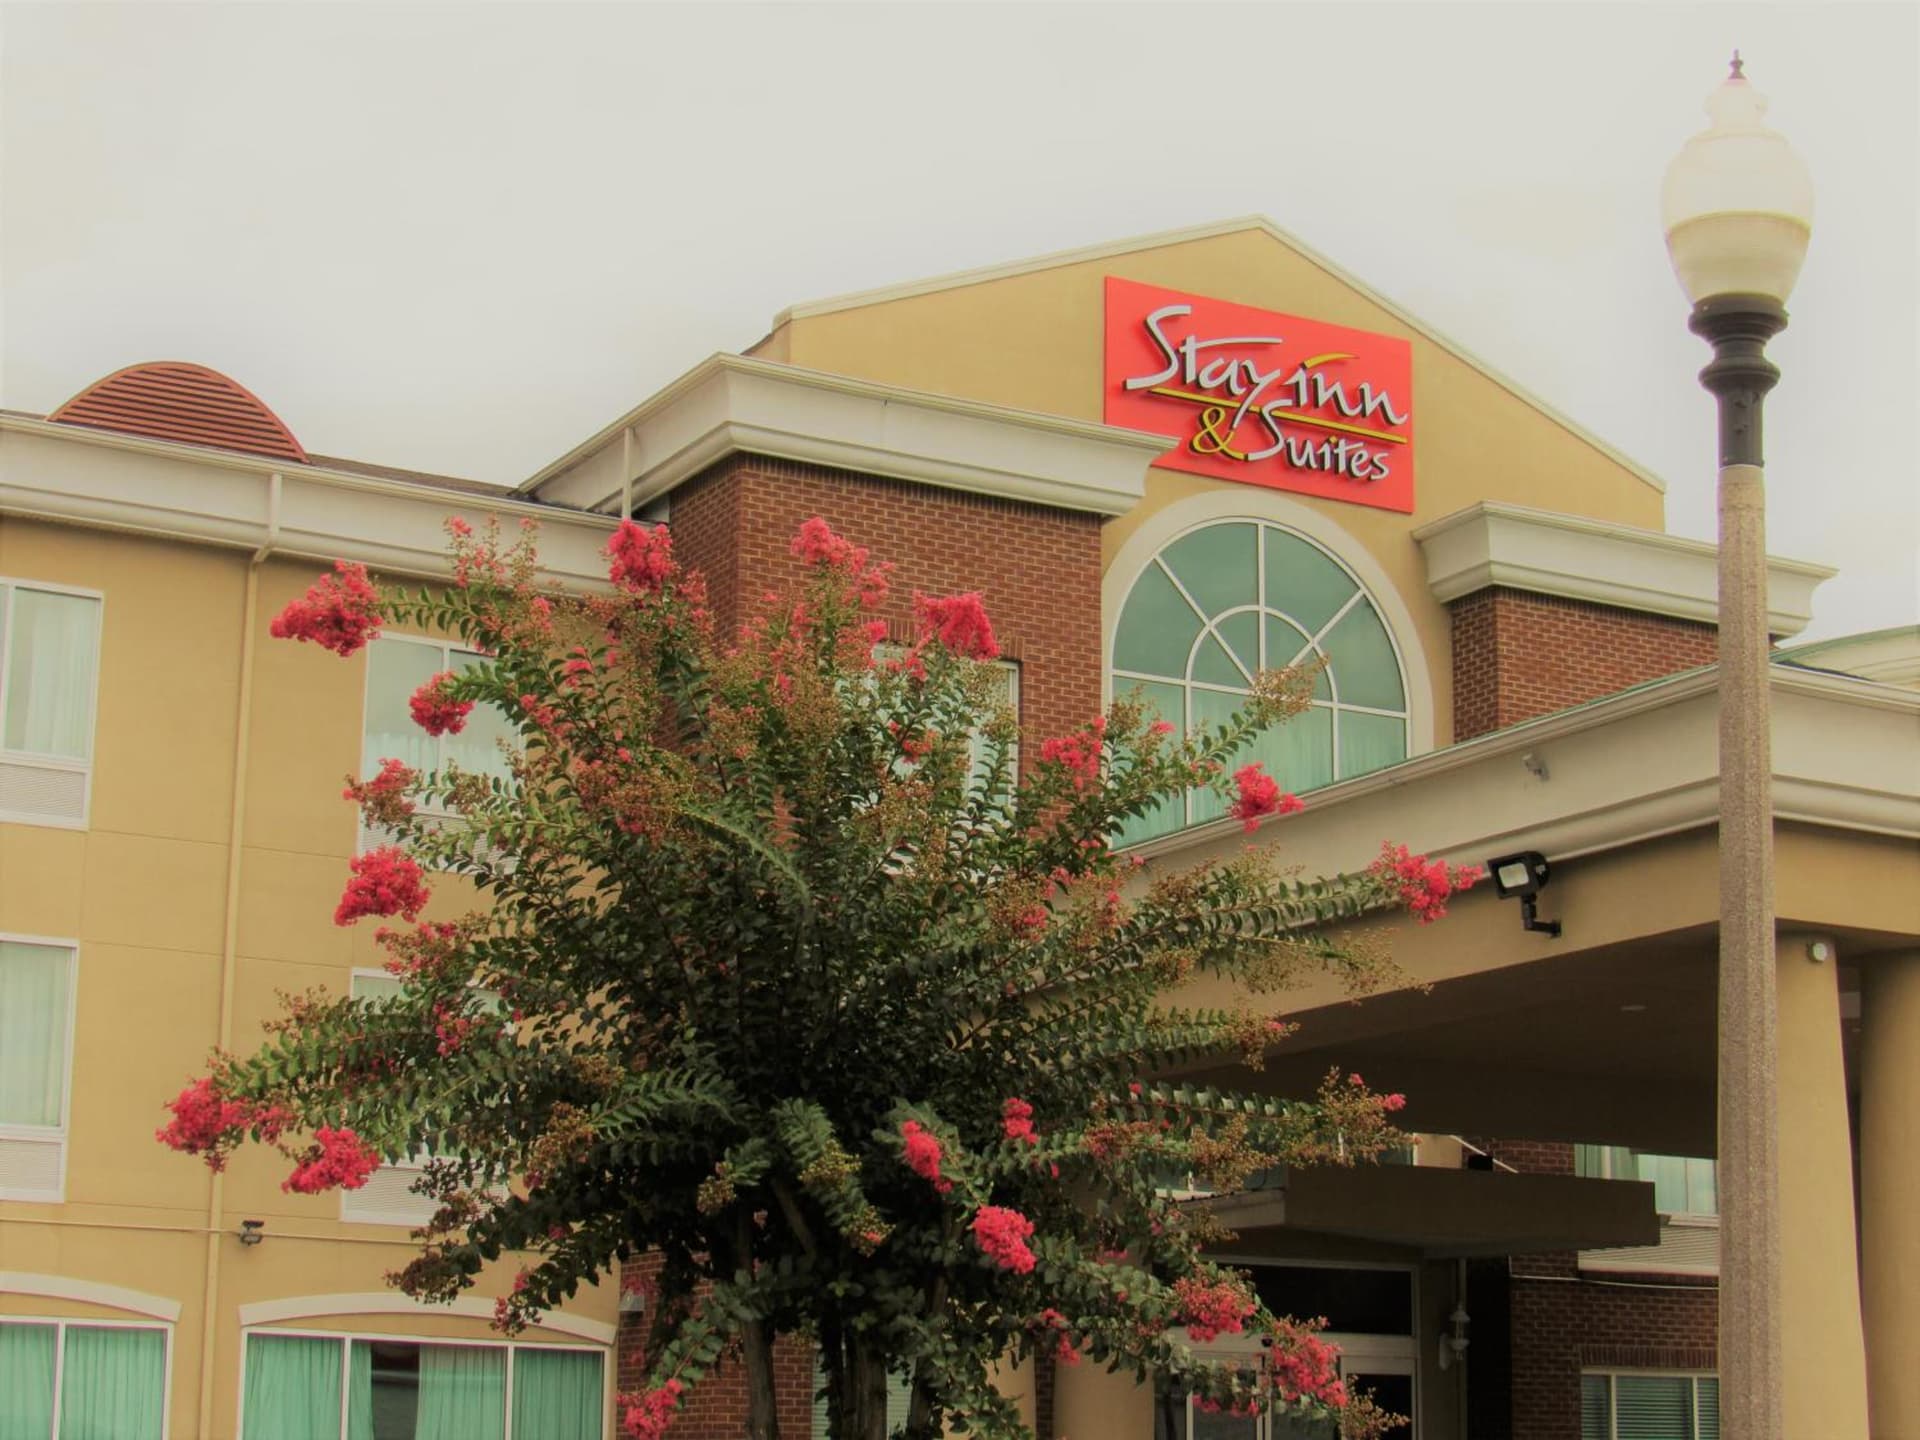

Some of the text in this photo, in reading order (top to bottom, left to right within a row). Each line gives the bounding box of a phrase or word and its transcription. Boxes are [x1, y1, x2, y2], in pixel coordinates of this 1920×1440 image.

[1124, 304, 1283, 429] Stay
[1191, 398, 1390, 481] & Suites
